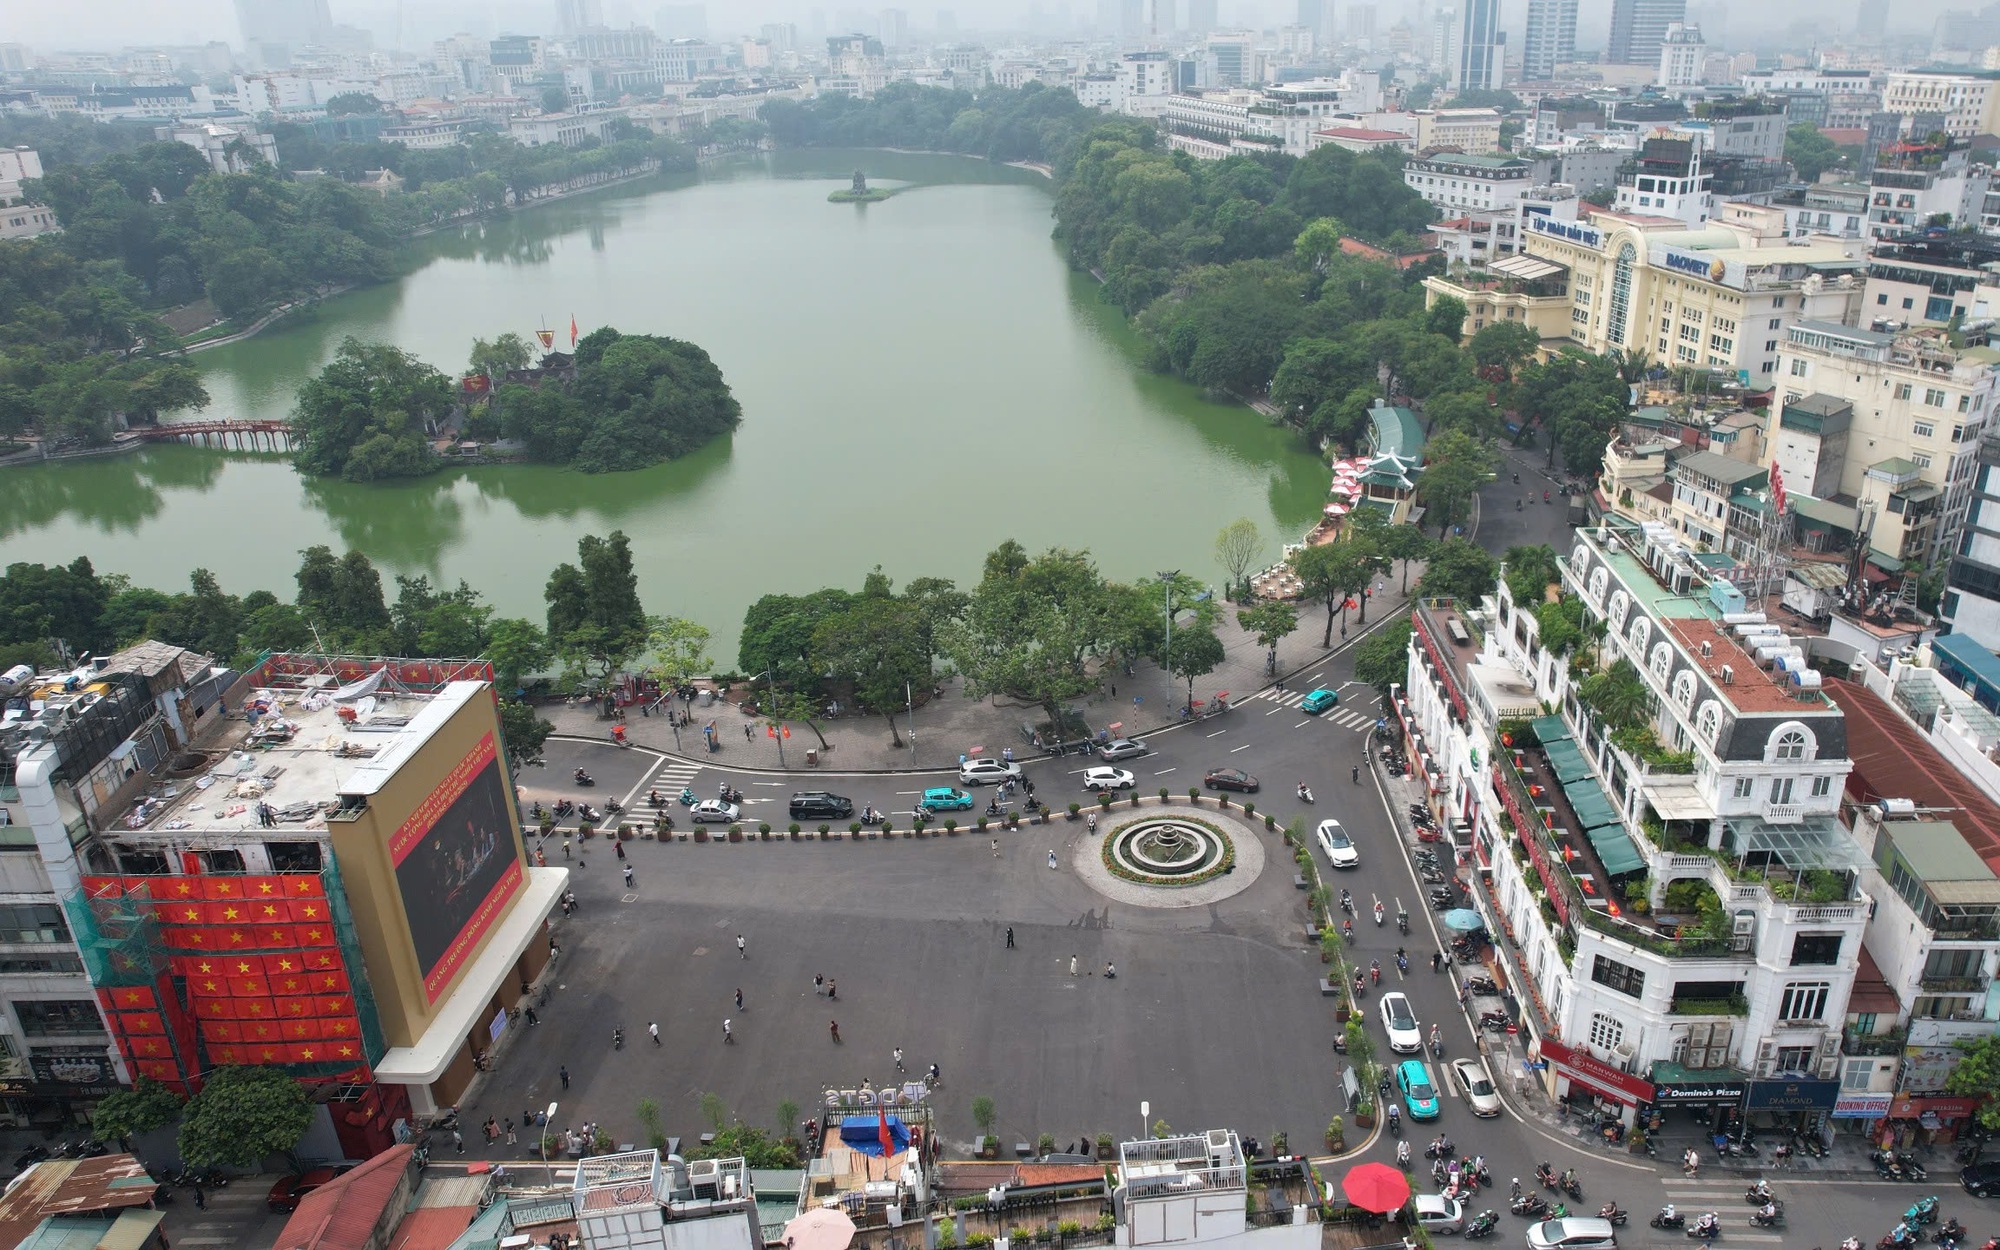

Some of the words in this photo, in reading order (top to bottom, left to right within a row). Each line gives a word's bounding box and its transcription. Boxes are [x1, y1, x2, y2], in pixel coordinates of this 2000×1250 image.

[1666, 252, 1710, 276] BAOVIET
[1497, 708, 1520, 716] COFFEE
[1521, 708, 1536, 716] CLUB
[1585, 1062, 1624, 1082] MANWAH
[1671, 1089, 1714, 1097] Domino's
[1768, 1097, 1813, 1105] DIAMOND
[1835, 1101, 1866, 1111] BOOKING
[1866, 1101, 1890, 1111] OFFICE
